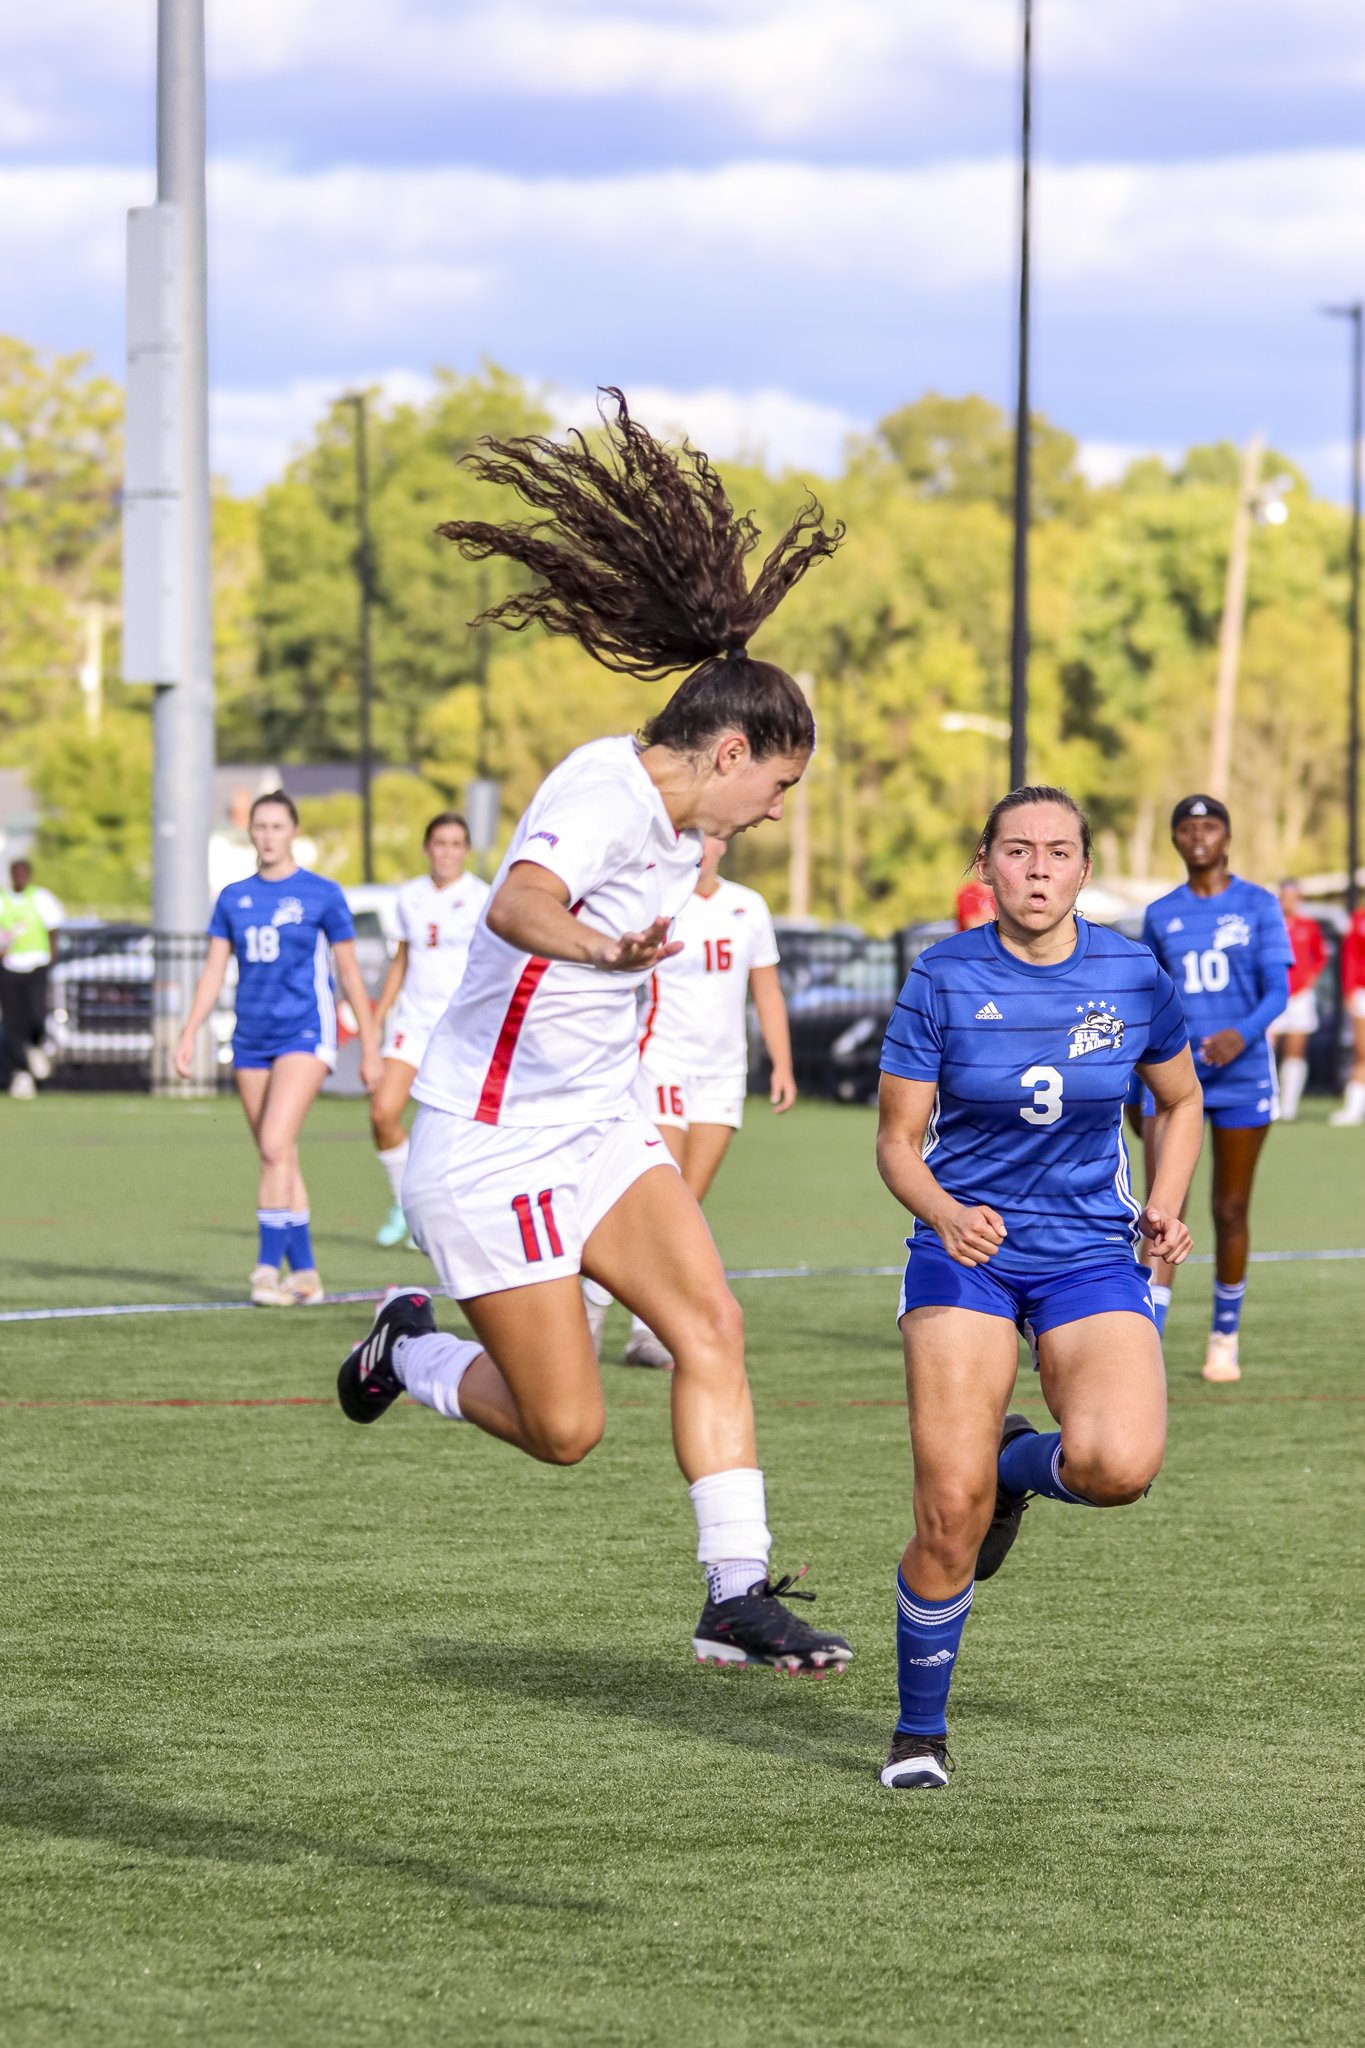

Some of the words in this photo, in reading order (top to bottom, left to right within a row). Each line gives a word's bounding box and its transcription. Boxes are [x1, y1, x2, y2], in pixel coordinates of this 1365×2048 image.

[244, 925, 280, 962] 18
[425, 922, 438, 948] 3
[704, 939, 731, 971] 16
[1182, 950, 1230, 993] 10
[975, 1012, 1003, 1020] adidas
[1074, 1032, 1100, 1044] BLUE
[656, 1085, 684, 1116] 16
[1020, 1066, 1063, 1125] 3
[511, 1188, 564, 1263] 11
